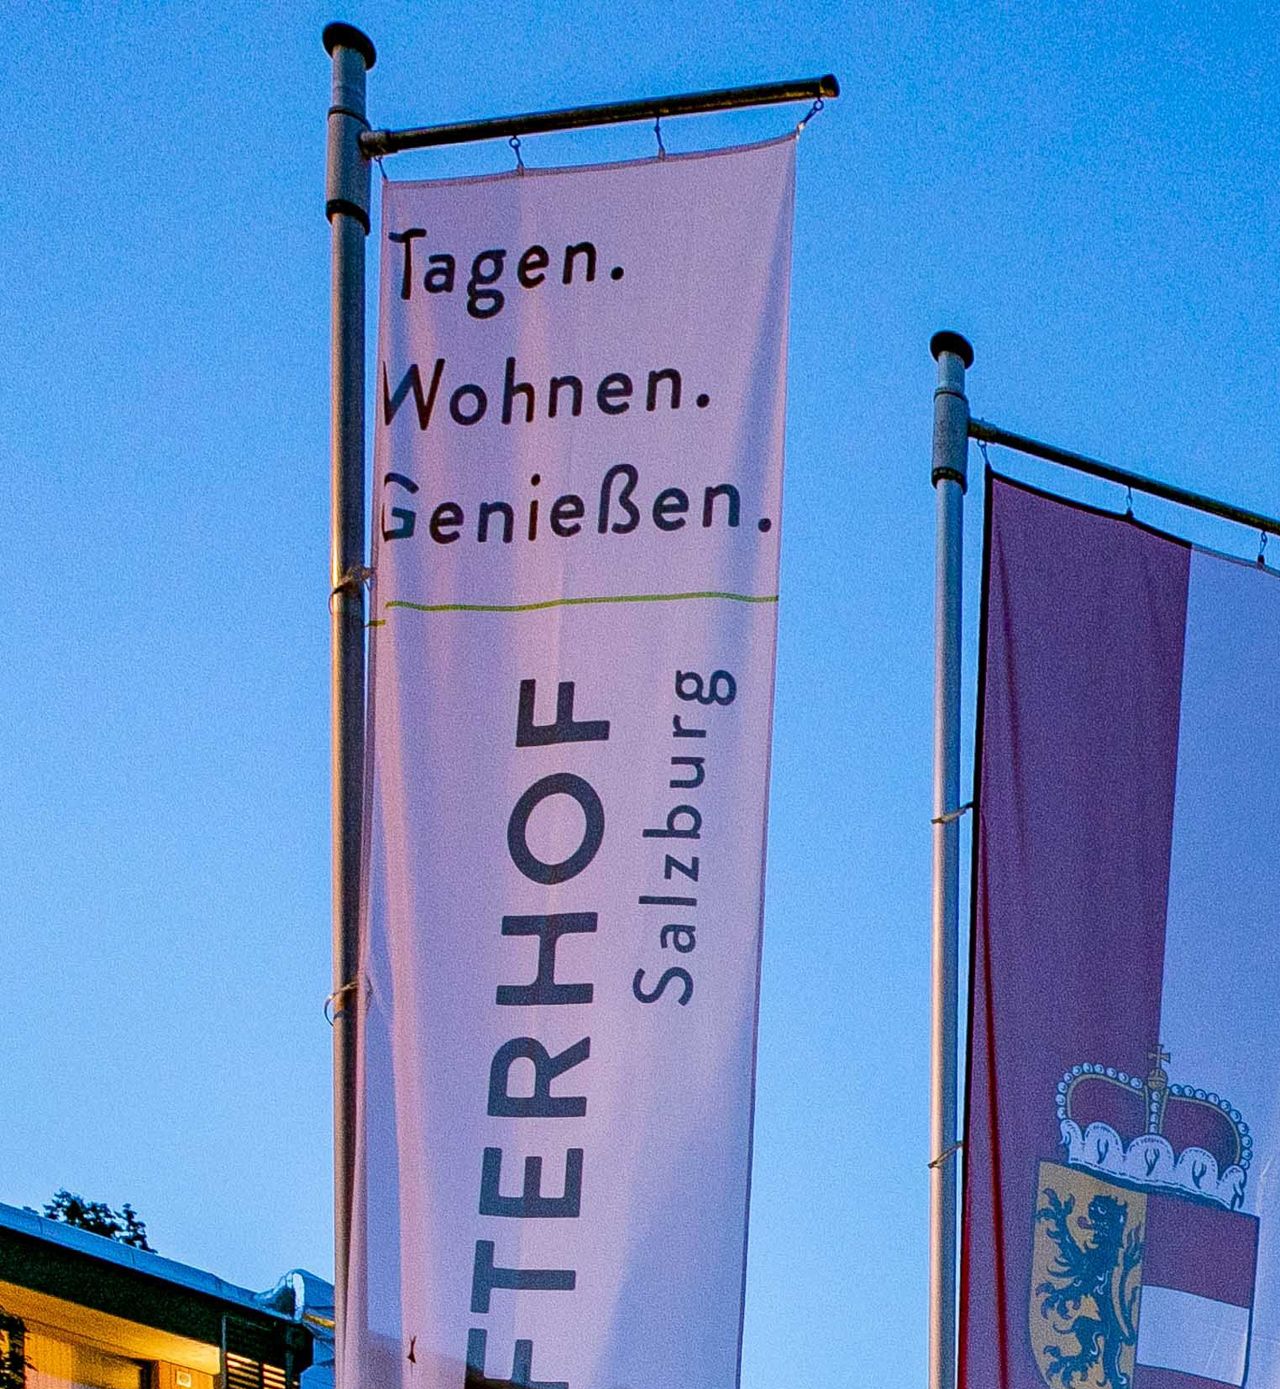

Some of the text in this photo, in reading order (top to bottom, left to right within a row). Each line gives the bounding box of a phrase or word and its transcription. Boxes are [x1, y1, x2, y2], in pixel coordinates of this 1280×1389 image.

[389, 227, 625, 319] Tagen.
[382, 356, 711, 431] Wohnen.
[381, 463, 773, 544] Genießen.
[632, 669, 738, 1006] Salzburg
